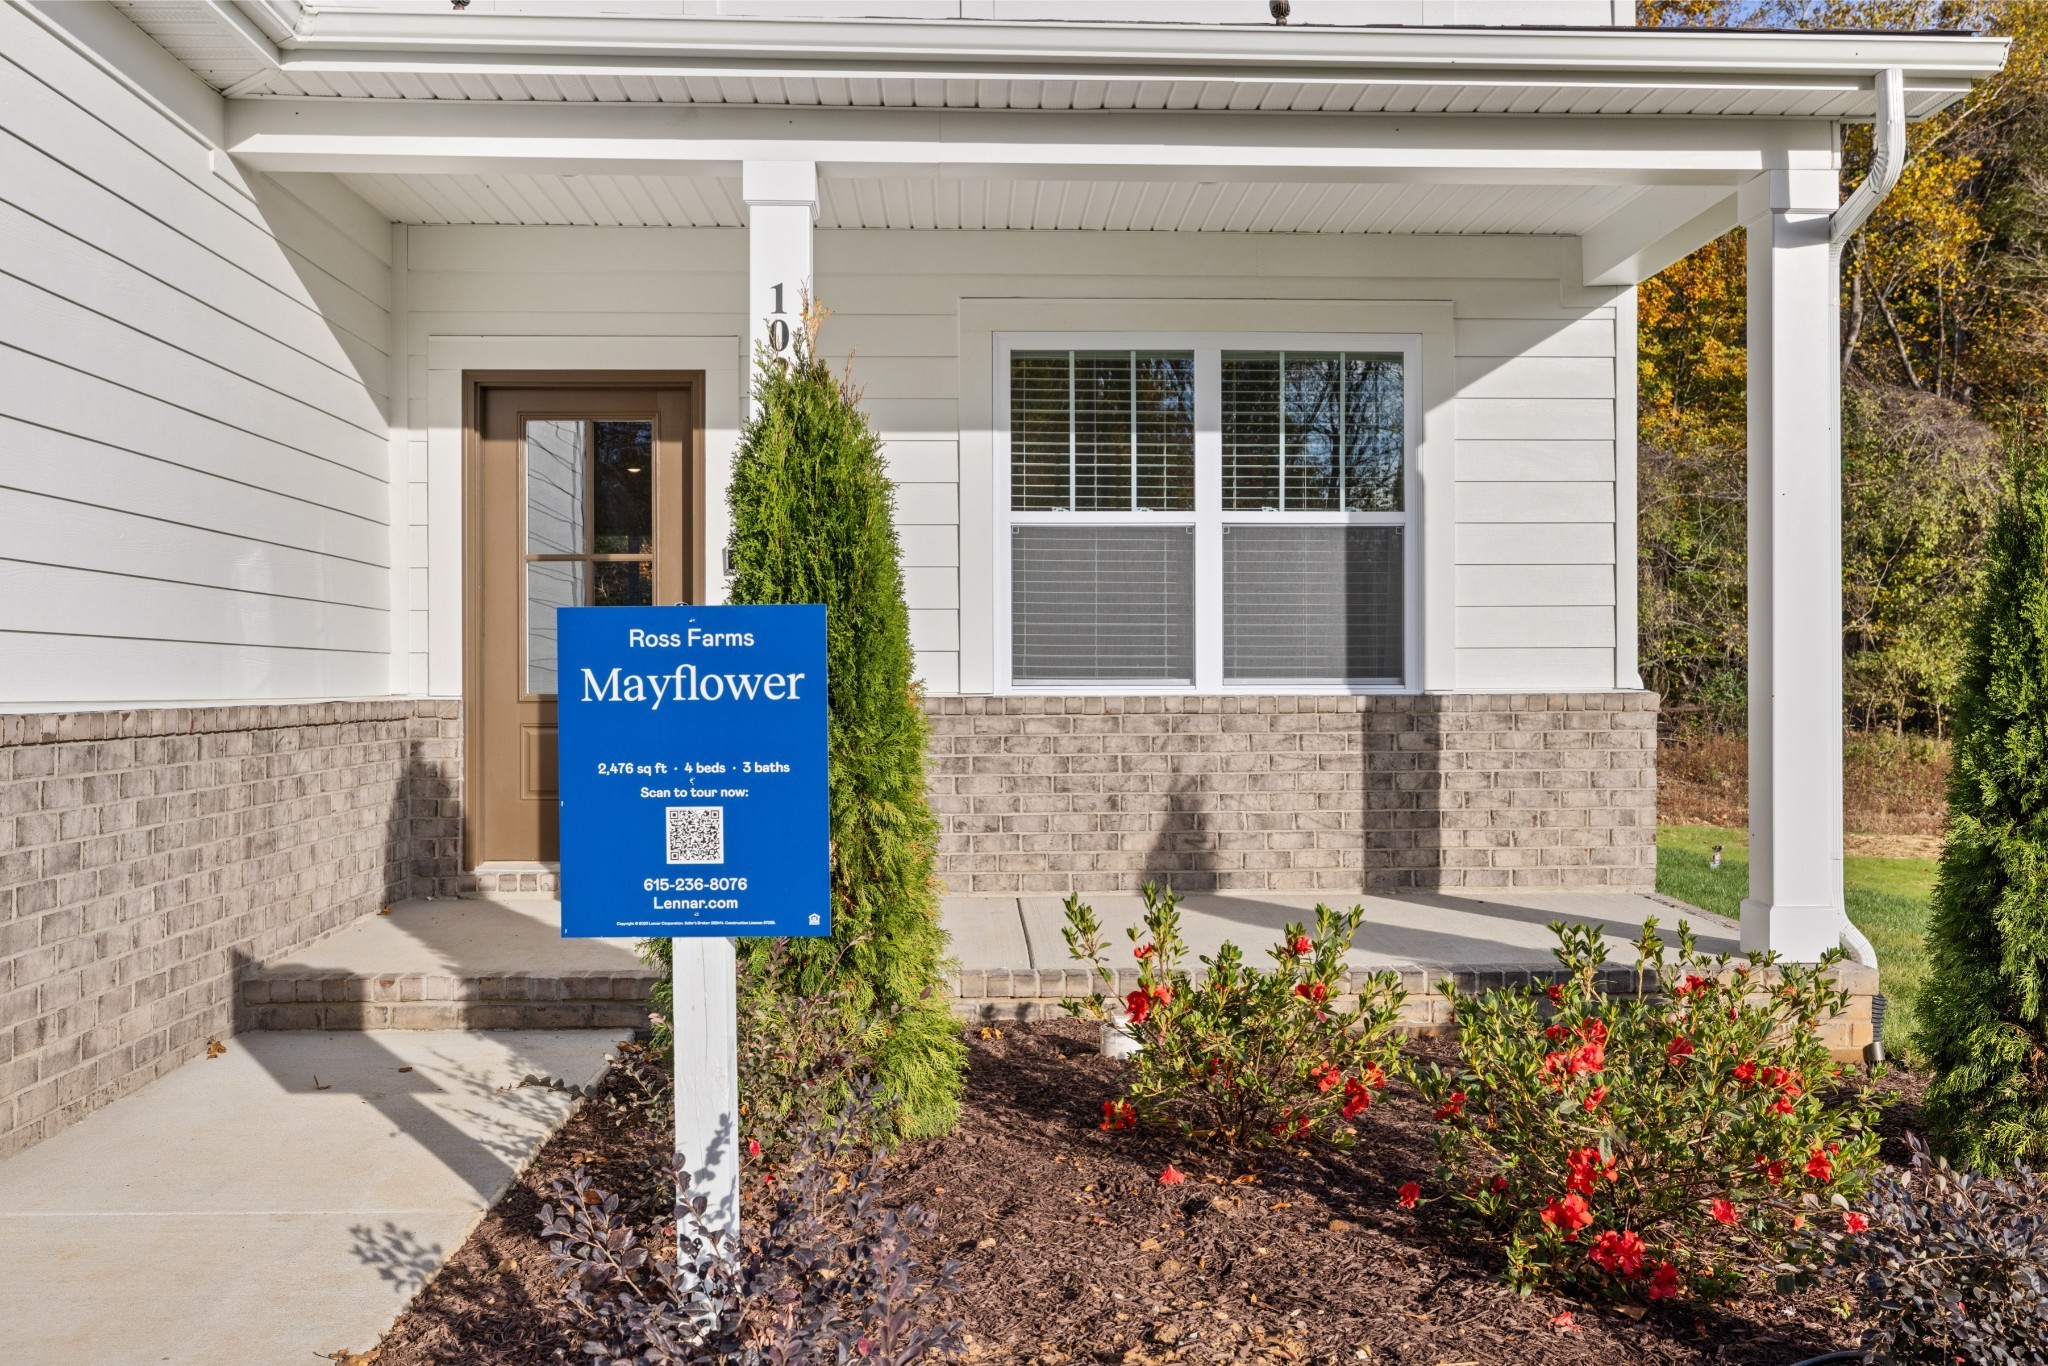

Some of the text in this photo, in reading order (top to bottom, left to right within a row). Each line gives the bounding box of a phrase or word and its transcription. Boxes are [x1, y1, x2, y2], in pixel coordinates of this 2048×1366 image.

[629, 627, 755, 647] Ross Farms
[580, 663, 806, 711] Mayflower
[598, 761, 791, 777] 2,476 sq ft 4 beds 3 baths
[640, 786, 749, 798] Scan to tour now:
[643, 877, 748, 892] 615-236-8076
[653, 896, 739, 910] Lennar.com
